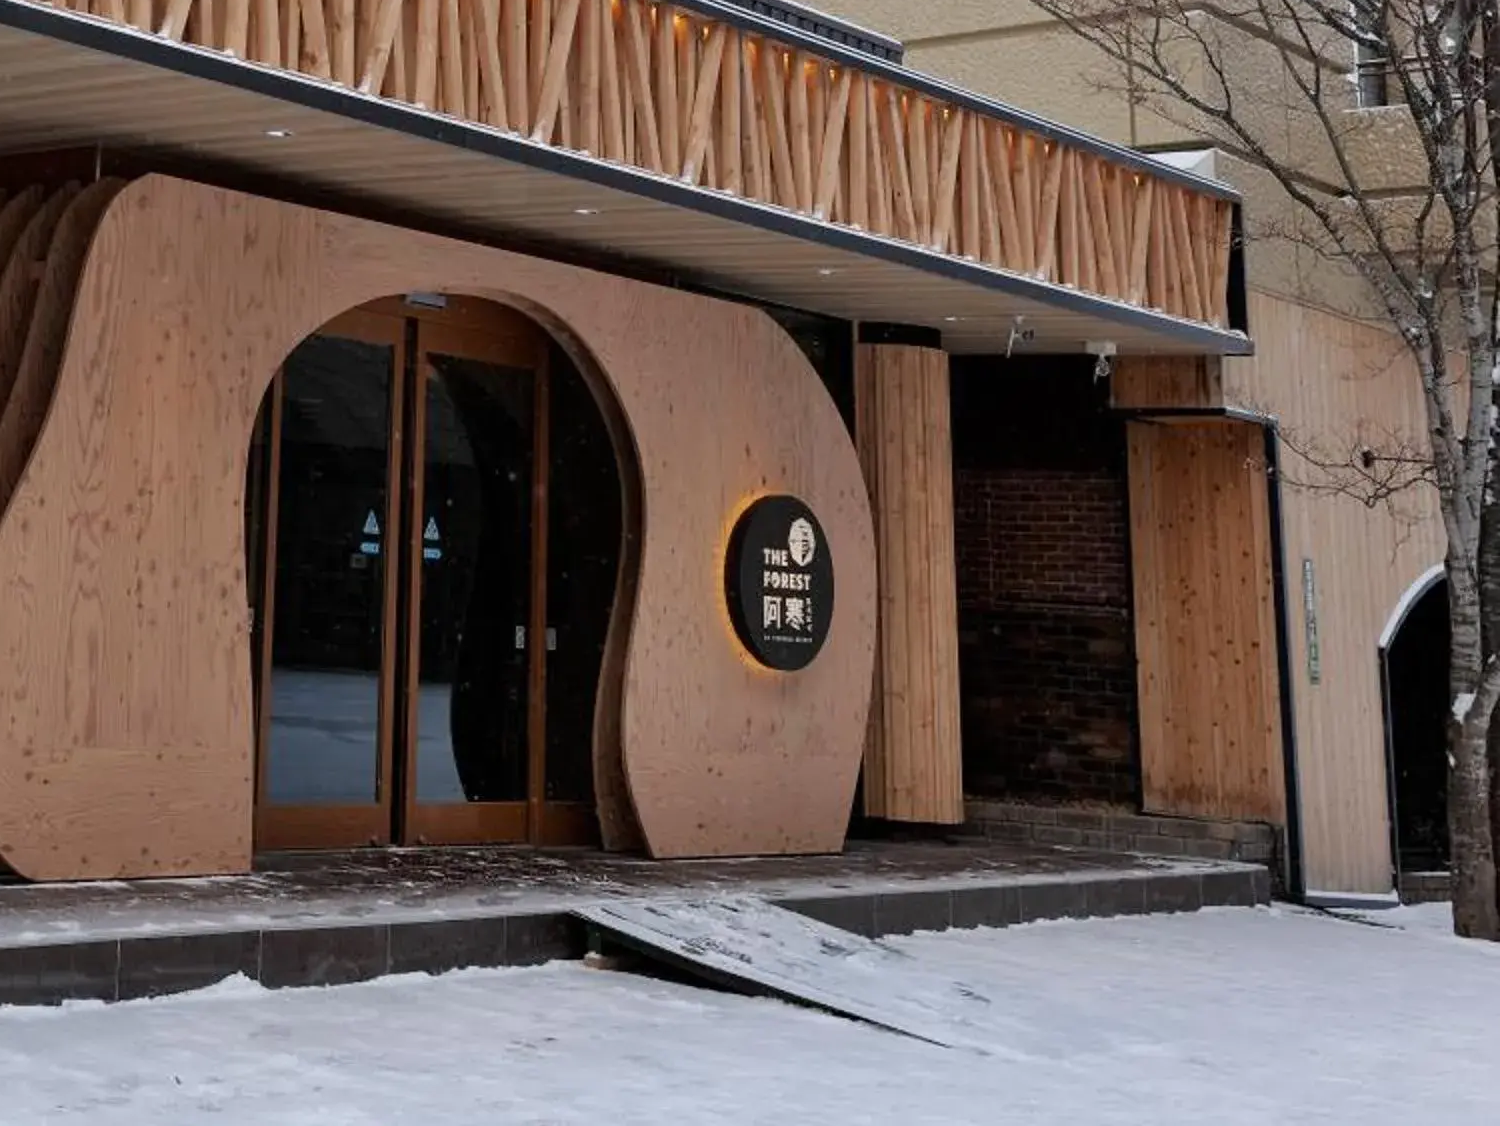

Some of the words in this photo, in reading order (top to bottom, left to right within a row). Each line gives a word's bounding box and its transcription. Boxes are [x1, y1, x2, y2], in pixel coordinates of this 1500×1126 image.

[763, 548, 788, 566] THE
[763, 571, 812, 590] FOREST
[763, 595, 805, 631] 阿寒
